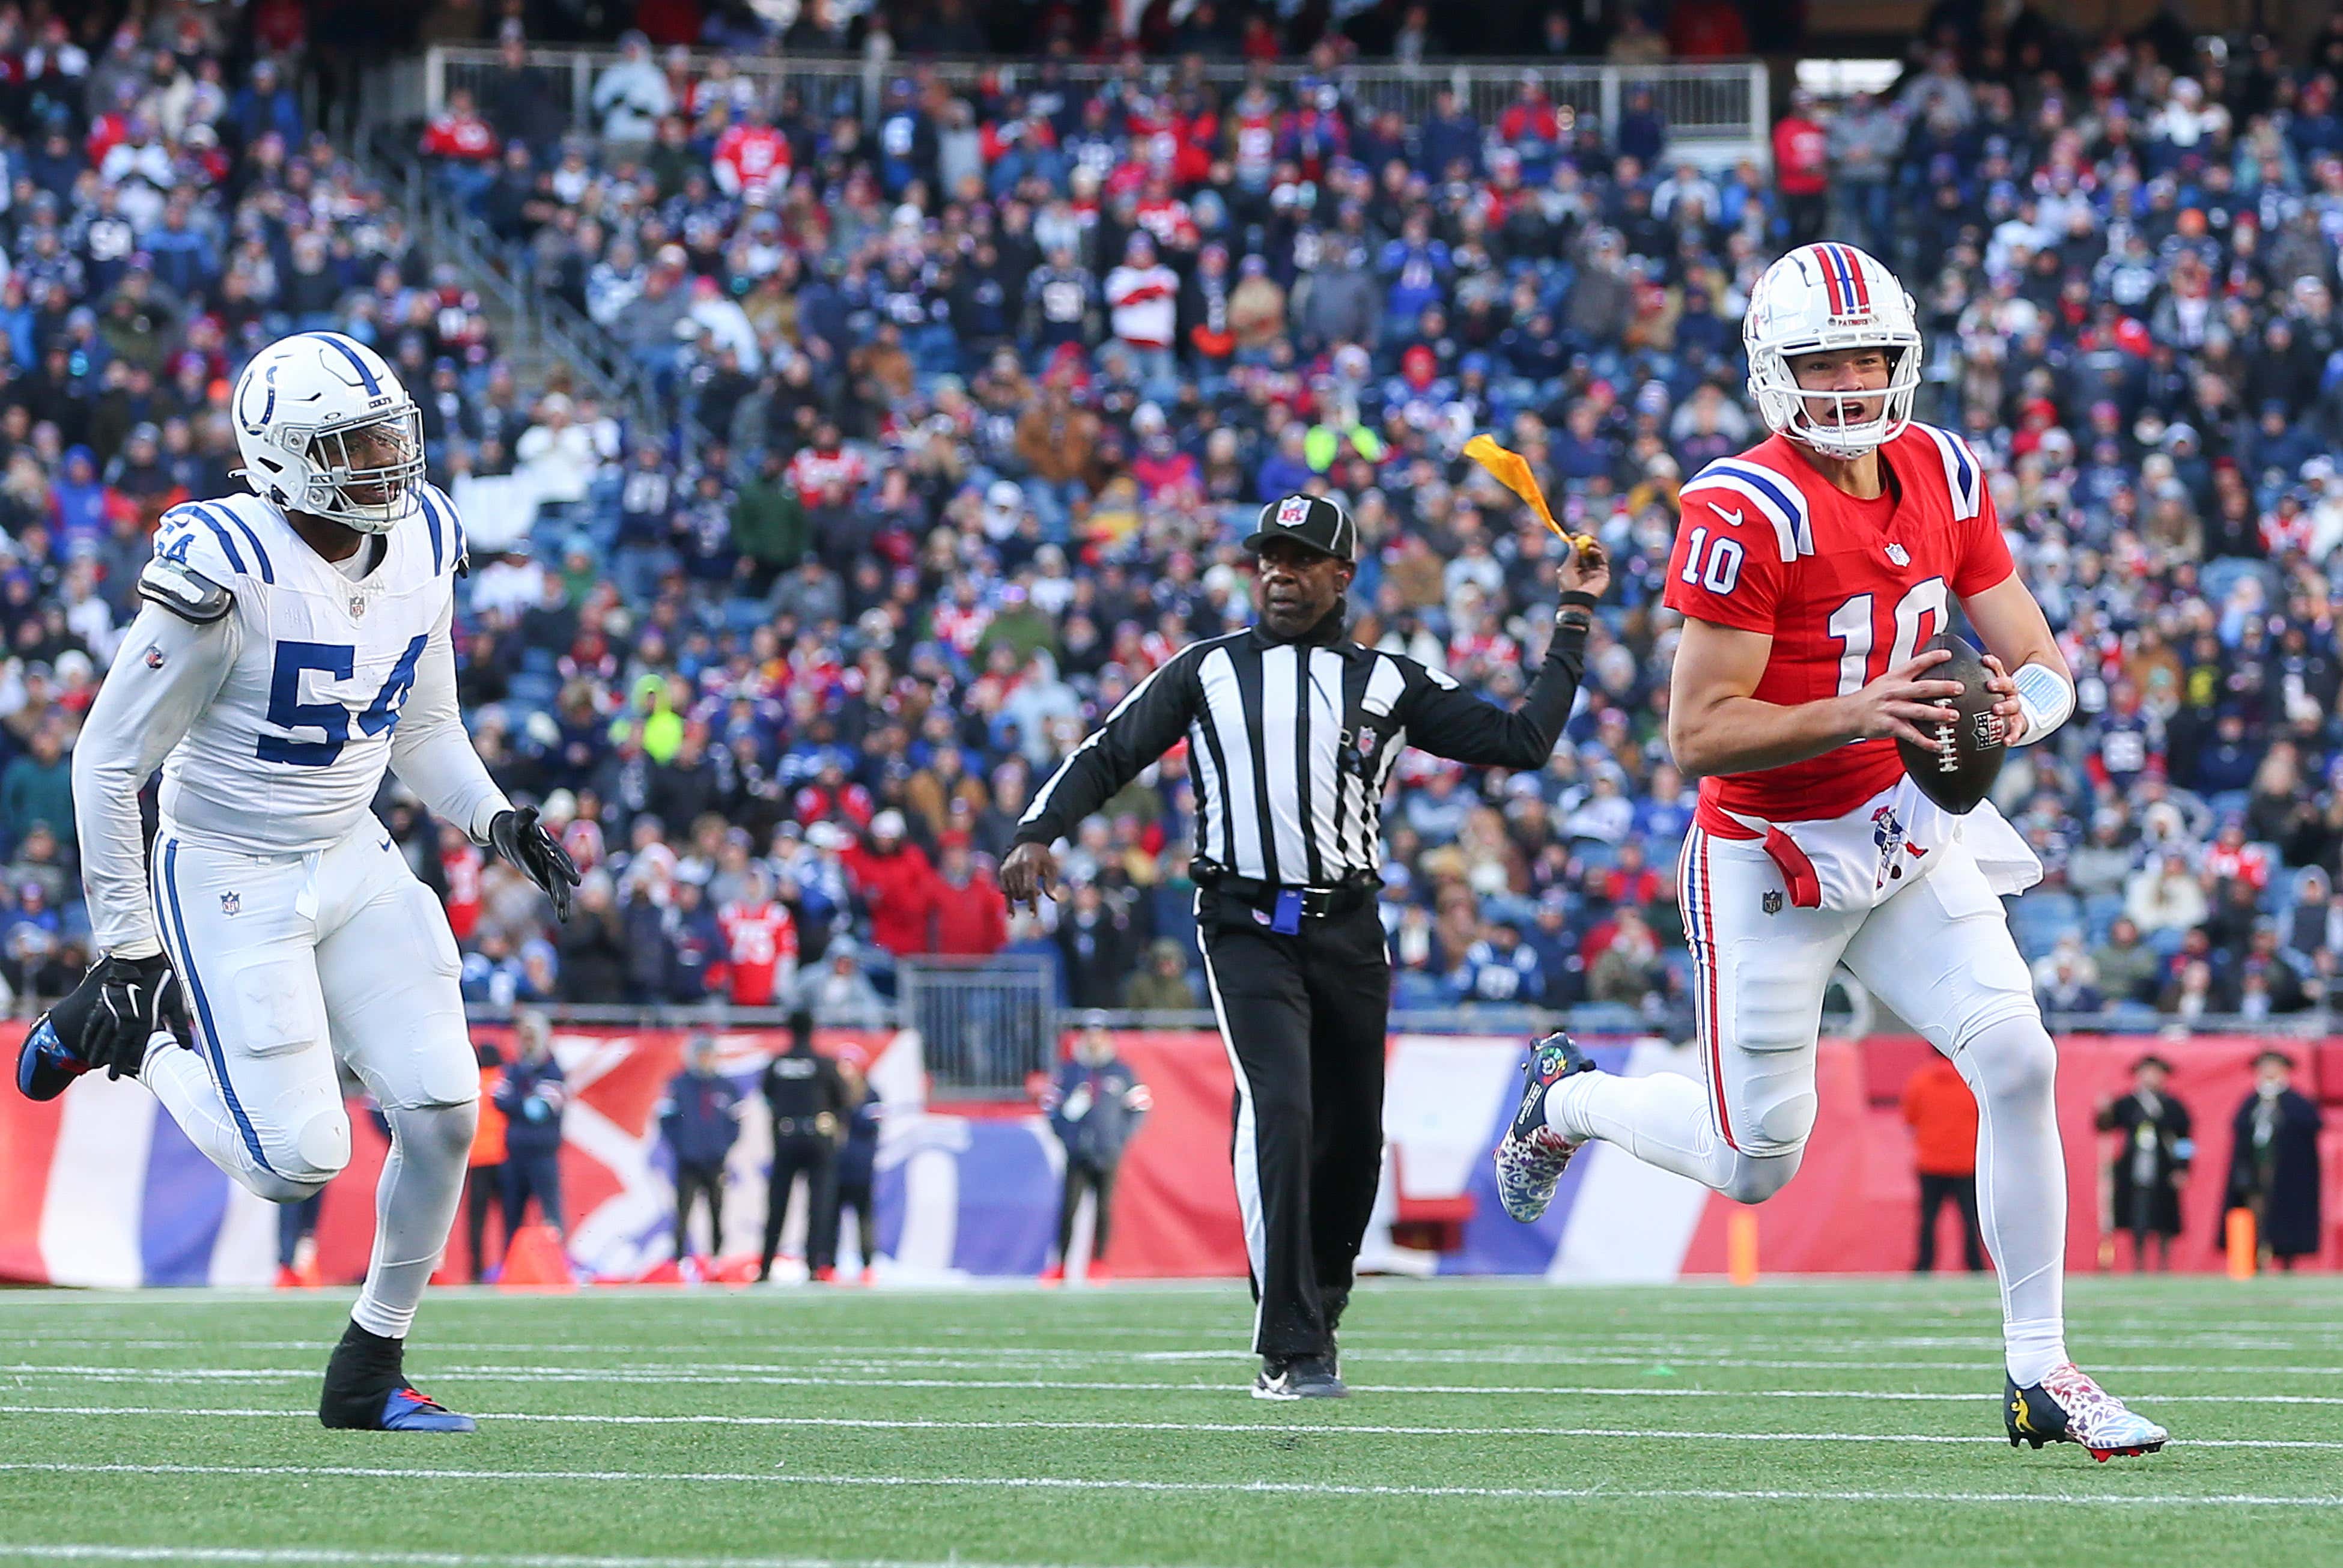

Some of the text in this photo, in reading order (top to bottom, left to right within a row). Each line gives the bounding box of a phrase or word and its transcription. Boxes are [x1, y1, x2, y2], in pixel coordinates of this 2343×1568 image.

[1681, 526, 1745, 596] 10
[256, 633, 428, 767] 54
[1989, 716, 2004, 743] NFL
